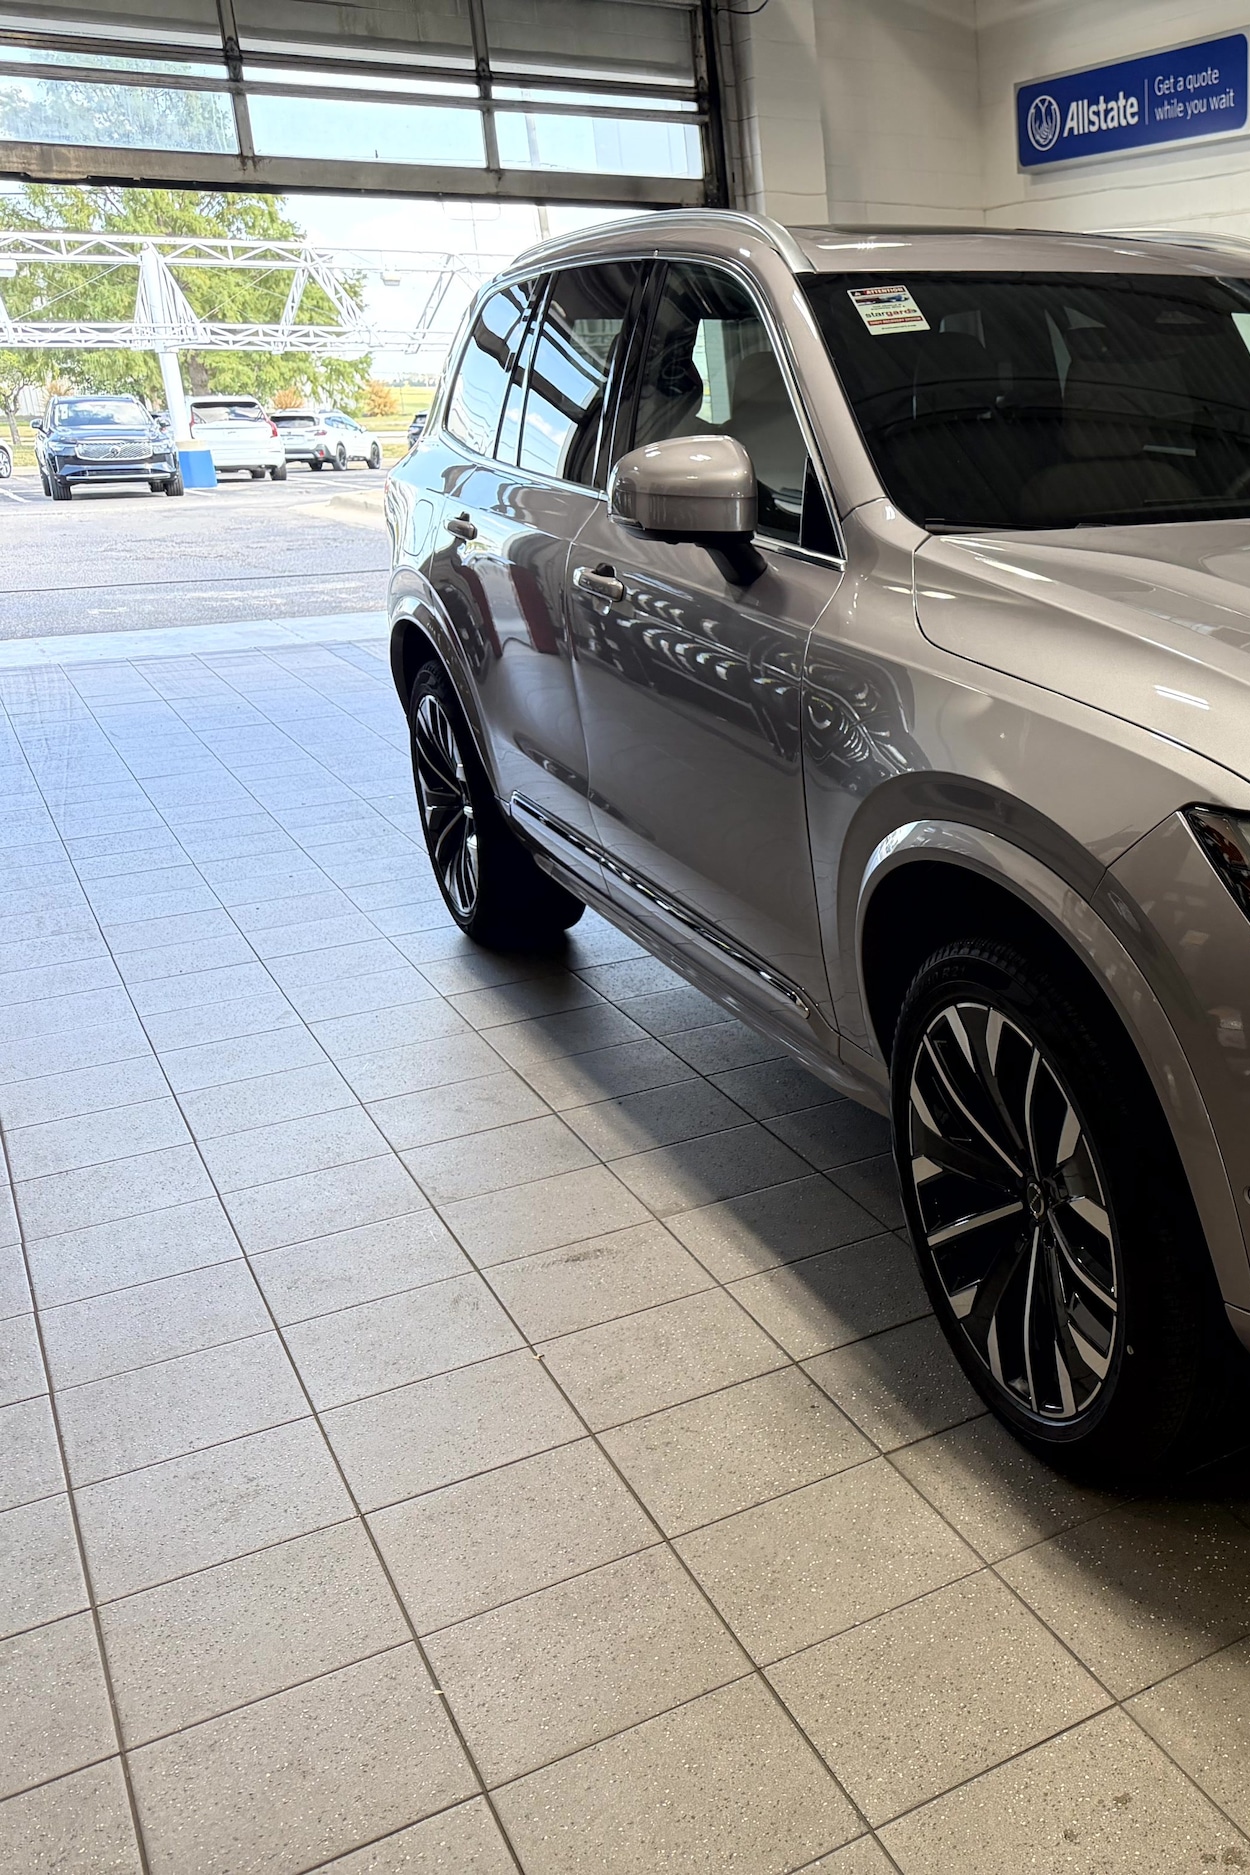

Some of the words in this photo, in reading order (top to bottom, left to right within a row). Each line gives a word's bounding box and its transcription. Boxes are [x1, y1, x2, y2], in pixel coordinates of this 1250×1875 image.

[1154, 75, 1175, 96] Get
[1176, 77, 1184, 91] a
[1186, 67, 1220, 94] quote
[1063, 91, 1139, 138] Allstate
[1154, 99, 1184, 121] while
[1186, 98, 1207, 120] you
[1209, 88, 1235, 110] wait
